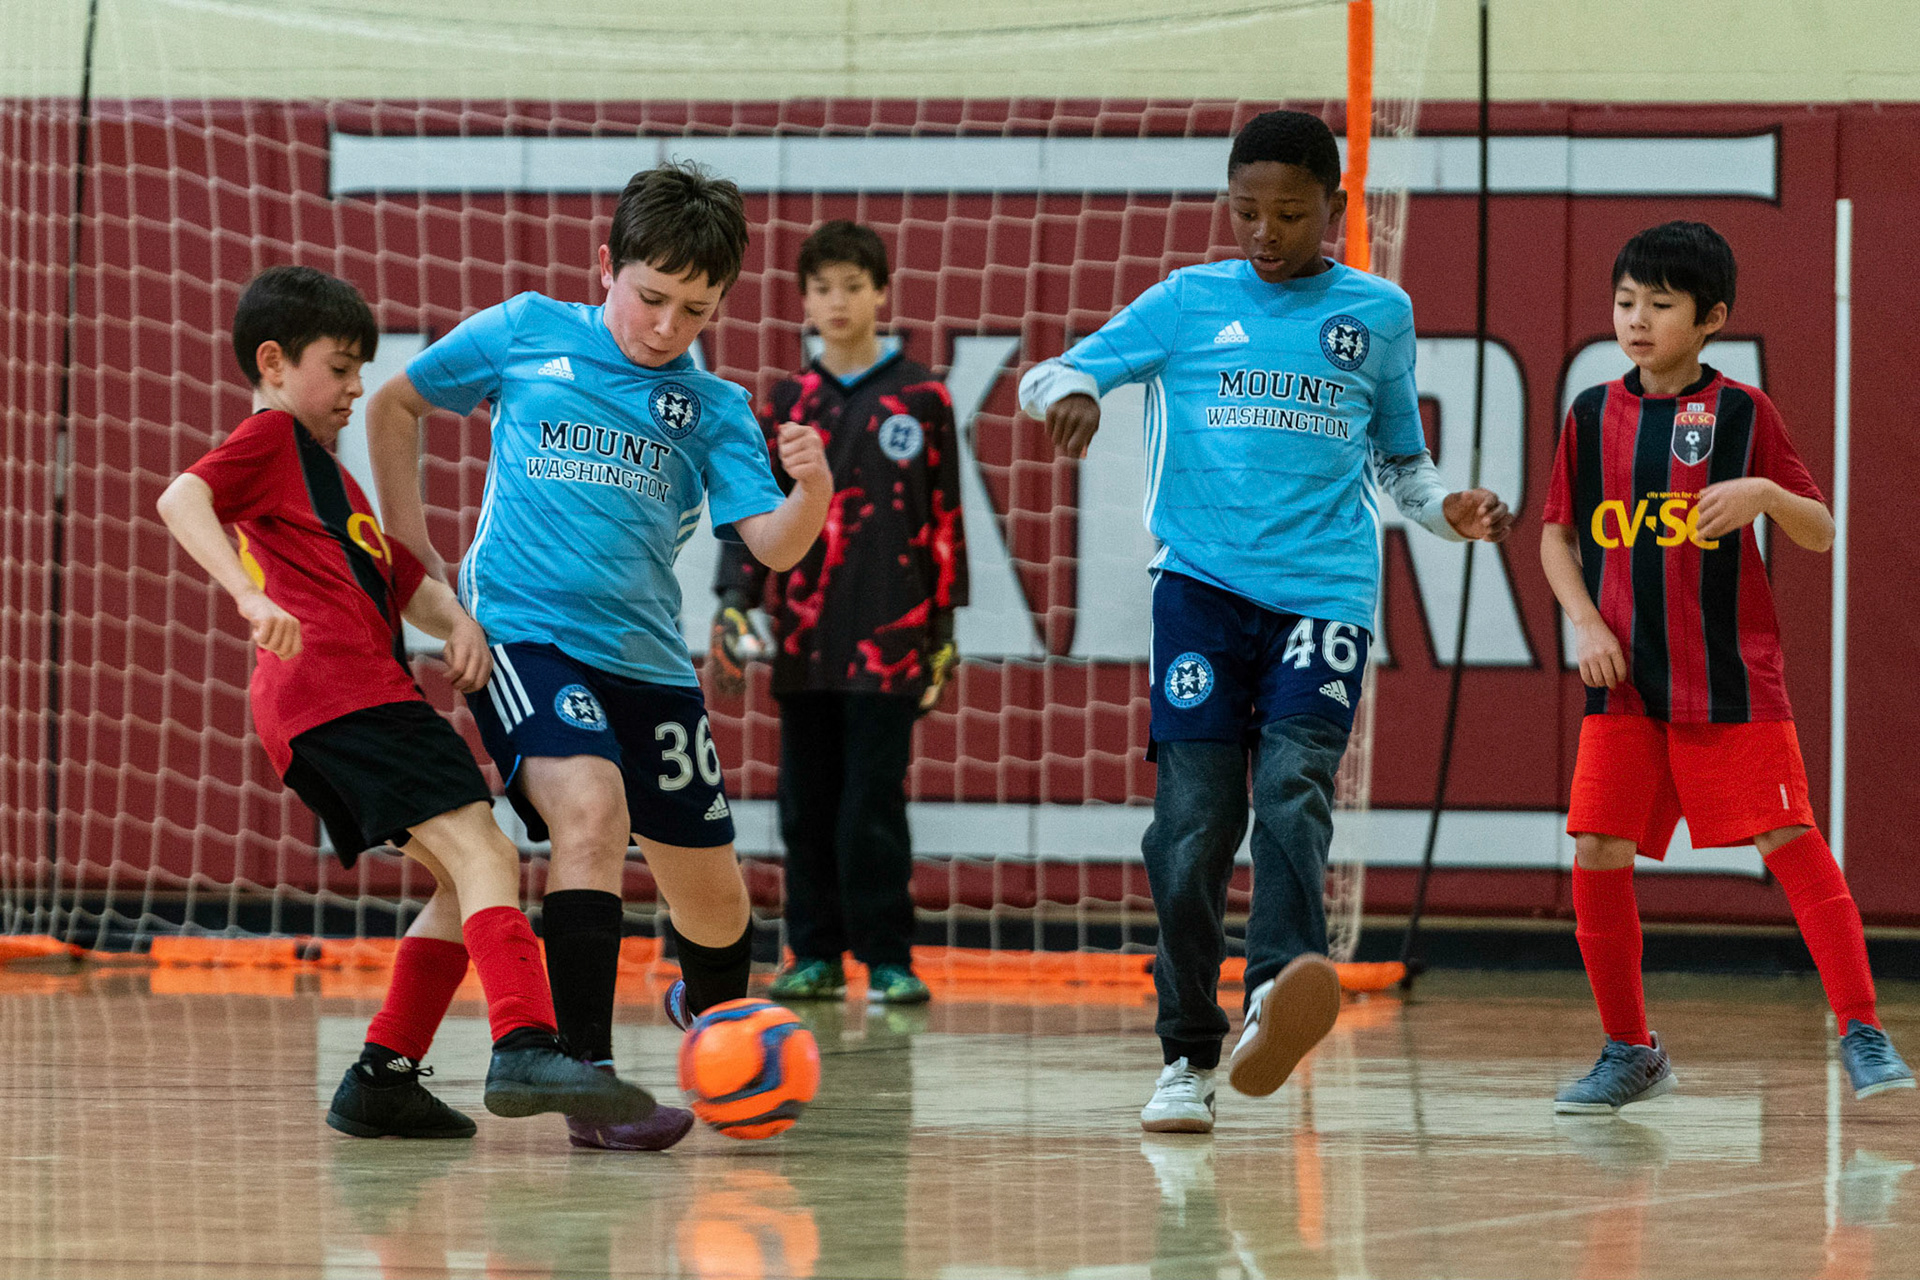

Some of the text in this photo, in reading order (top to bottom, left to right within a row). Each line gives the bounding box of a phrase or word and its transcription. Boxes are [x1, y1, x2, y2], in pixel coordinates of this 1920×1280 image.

[1213, 334, 1250, 344] adidas
[537, 367, 575, 381] adidas
[1218, 369, 1345, 409] MOUNT
[1207, 406, 1351, 441] WASHINGTON
[1681, 415, 1710, 424] CV SC
[540, 420, 671, 473] MOUNT
[526, 457, 670, 503] WASHINGTON
[1660, 491, 1680, 499] sports
[1681, 491, 1692, 499] for
[1282, 617, 1358, 673] 46
[655, 714, 722, 791] 36
